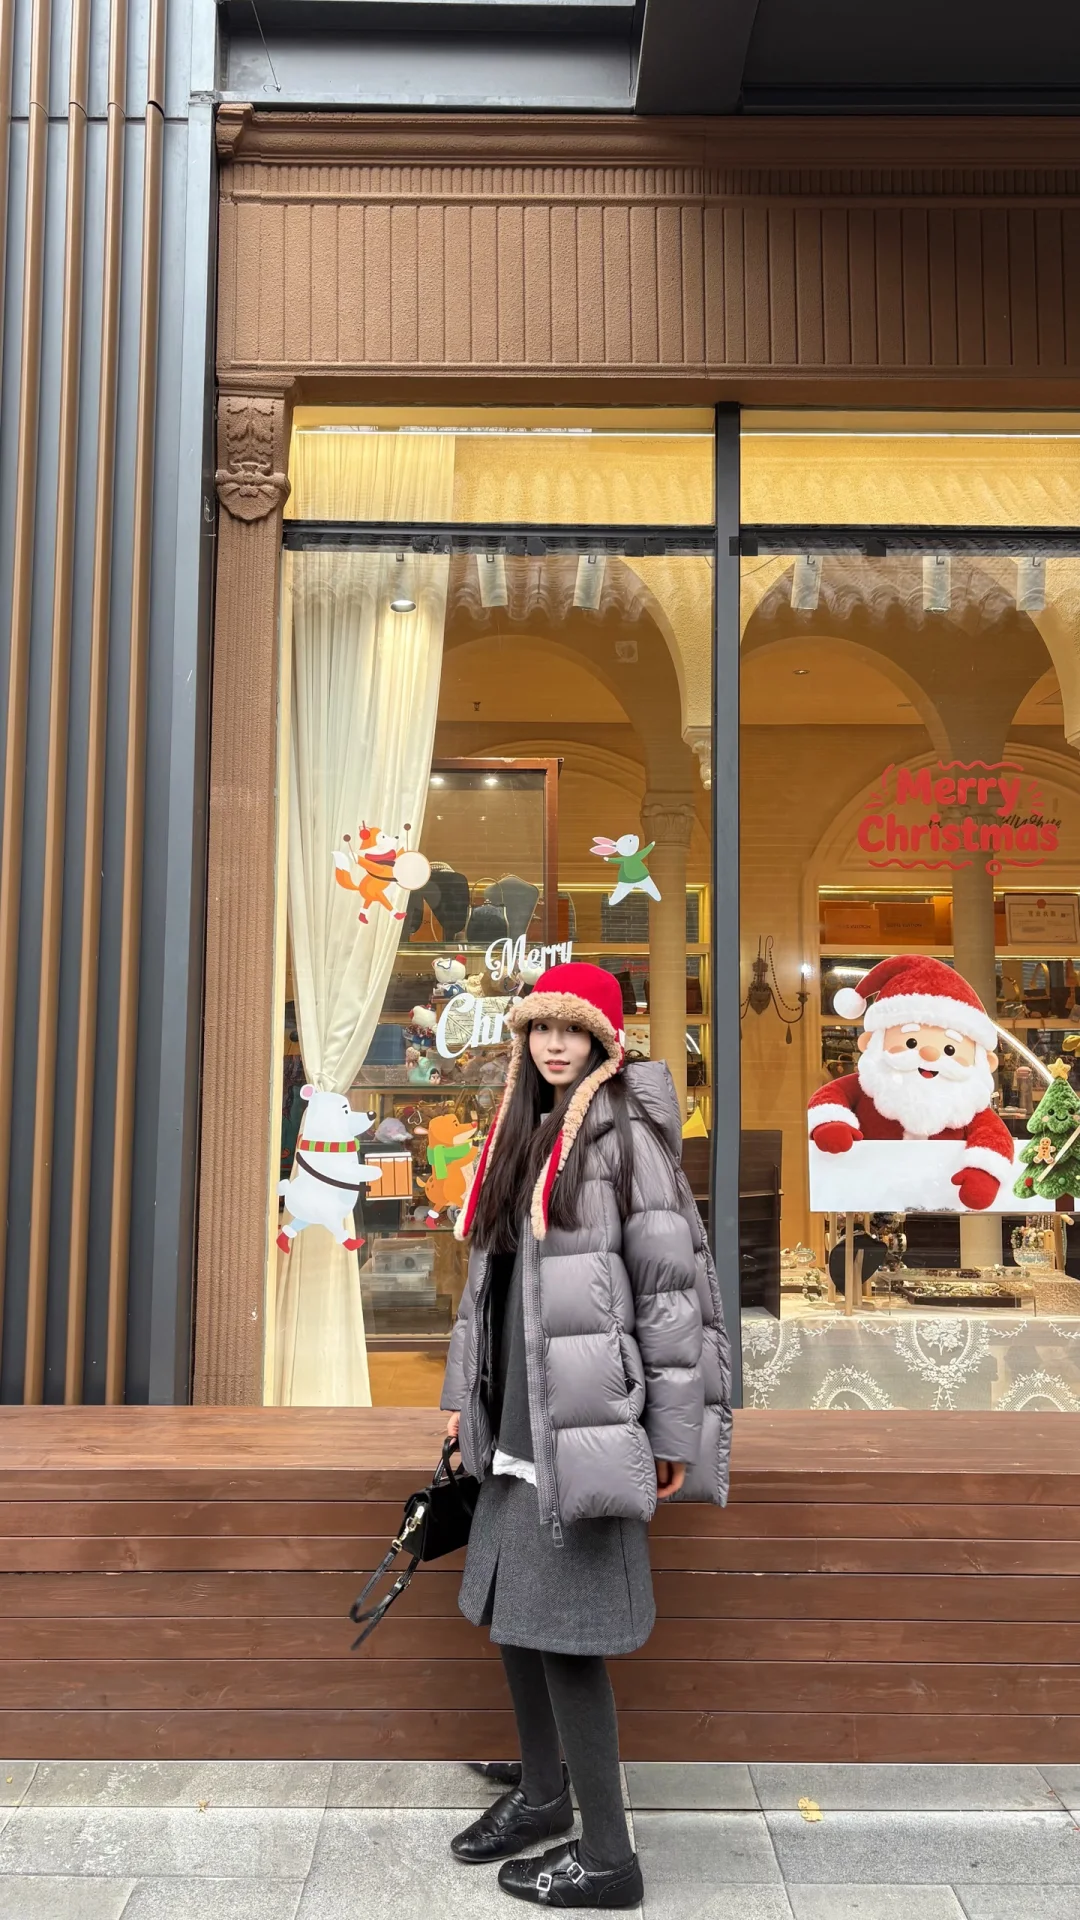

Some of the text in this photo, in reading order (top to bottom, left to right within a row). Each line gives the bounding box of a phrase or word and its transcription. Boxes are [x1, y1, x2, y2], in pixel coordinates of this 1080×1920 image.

[896, 768, 1021, 816] Merry
[857, 813, 1059, 852] Christmas
[485, 934, 573, 980] Merry
